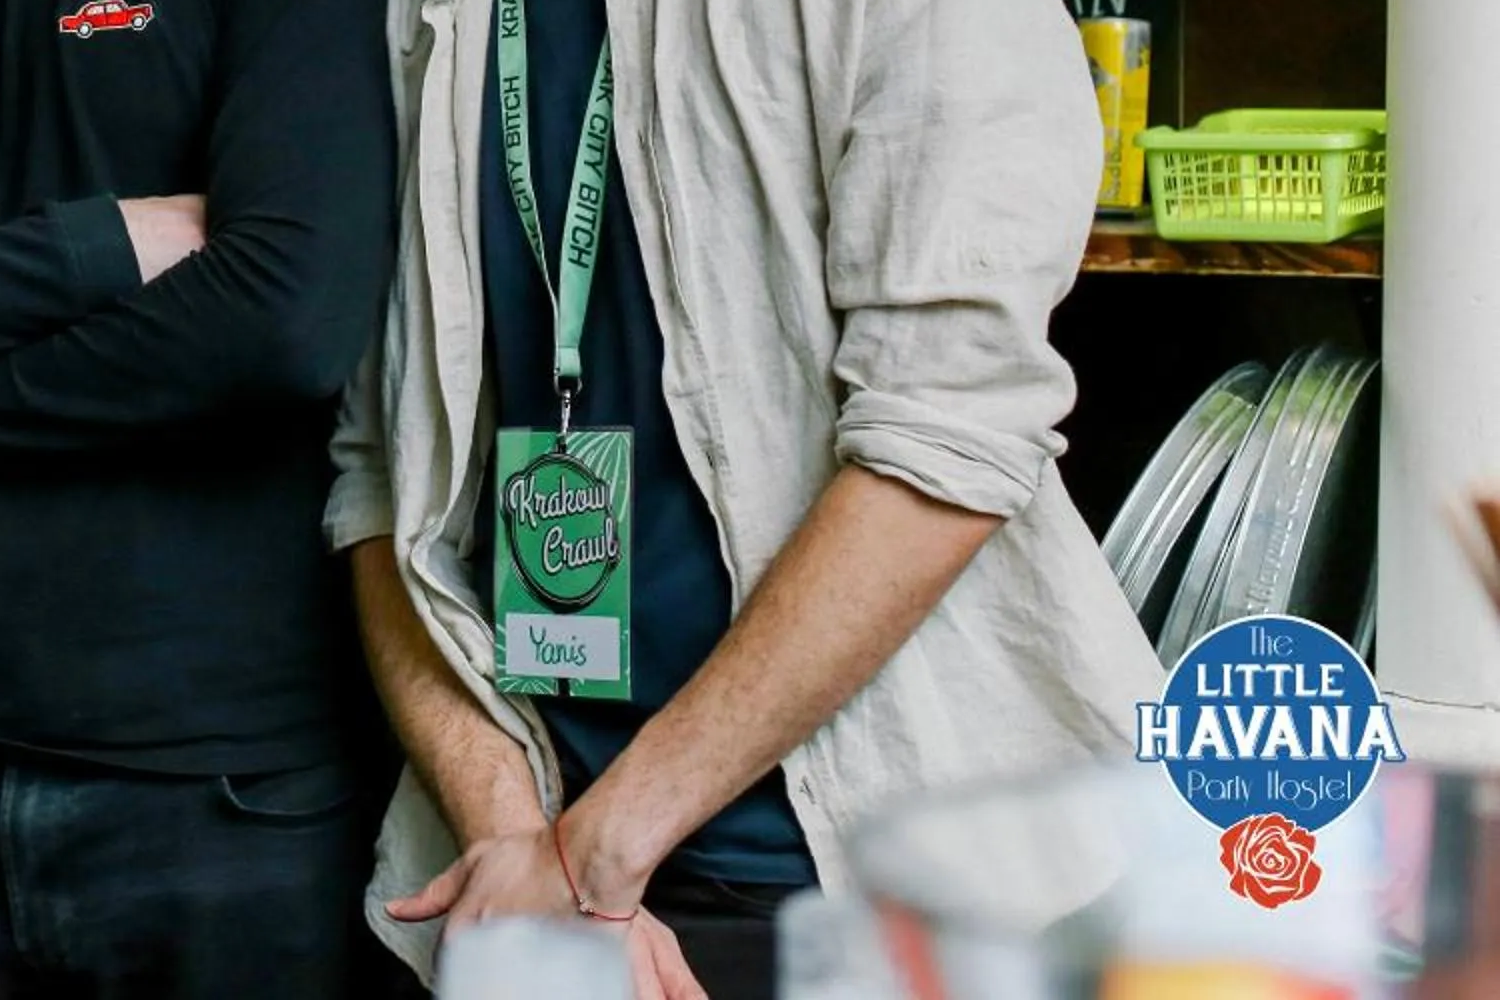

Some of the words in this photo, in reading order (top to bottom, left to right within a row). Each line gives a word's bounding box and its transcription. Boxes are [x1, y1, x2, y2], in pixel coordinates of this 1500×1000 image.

[504, 75, 521, 149] BITCH
[584, 112, 609, 178] CITY
[567, 181, 601, 269] BITCH
[510, 475, 617, 528] Krakow
[544, 517, 619, 573] Crawl
[528, 625, 587, 666] Yanis
